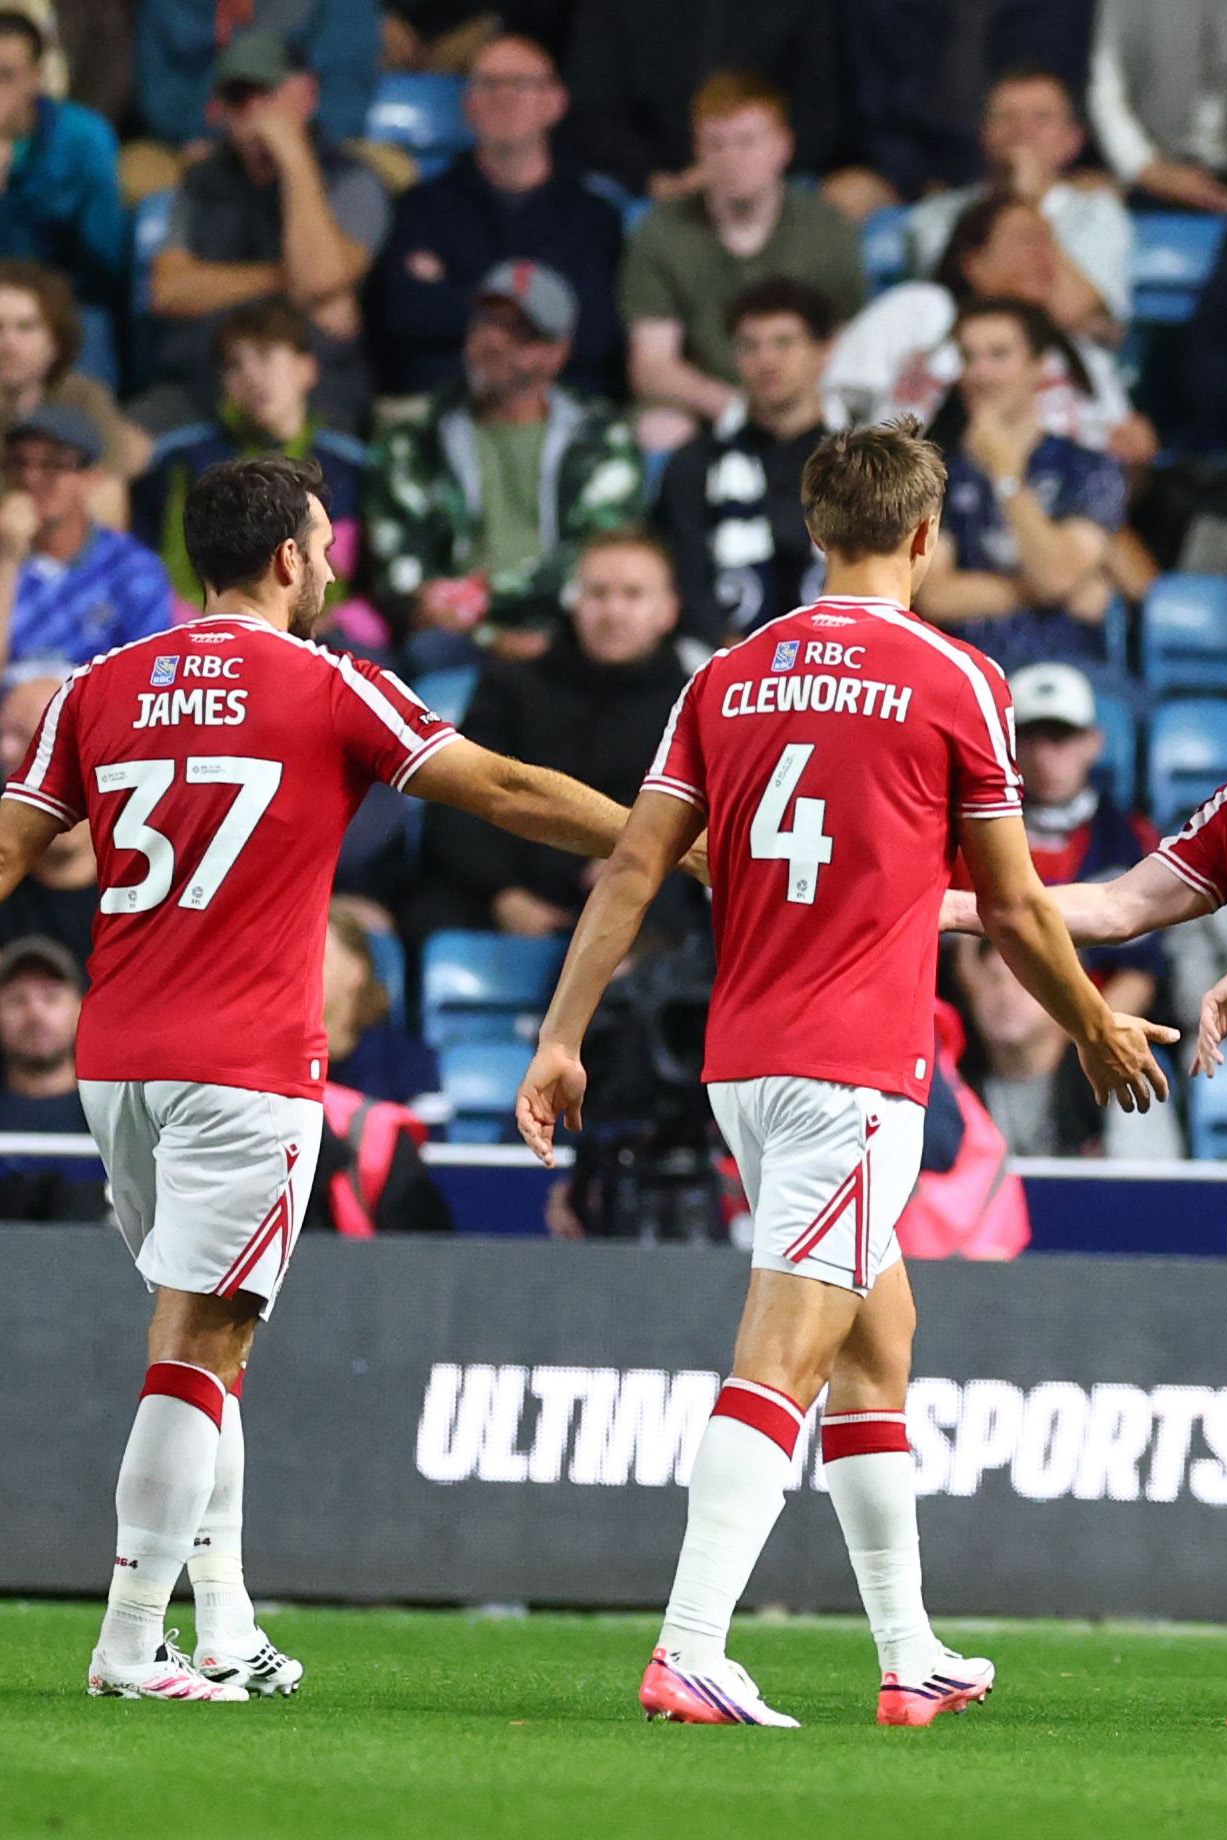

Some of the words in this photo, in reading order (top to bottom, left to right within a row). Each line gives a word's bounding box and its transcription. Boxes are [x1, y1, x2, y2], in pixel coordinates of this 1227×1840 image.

[183, 655, 244, 679] RBC
[804, 641, 866, 669] RBC
[132, 688, 249, 729] JAMES
[721, 674, 913, 723] CLEWORTH
[94, 757, 283, 914] 37
[750, 743, 833, 905] 4
[416, 1363, 829, 1491] ULTIM
